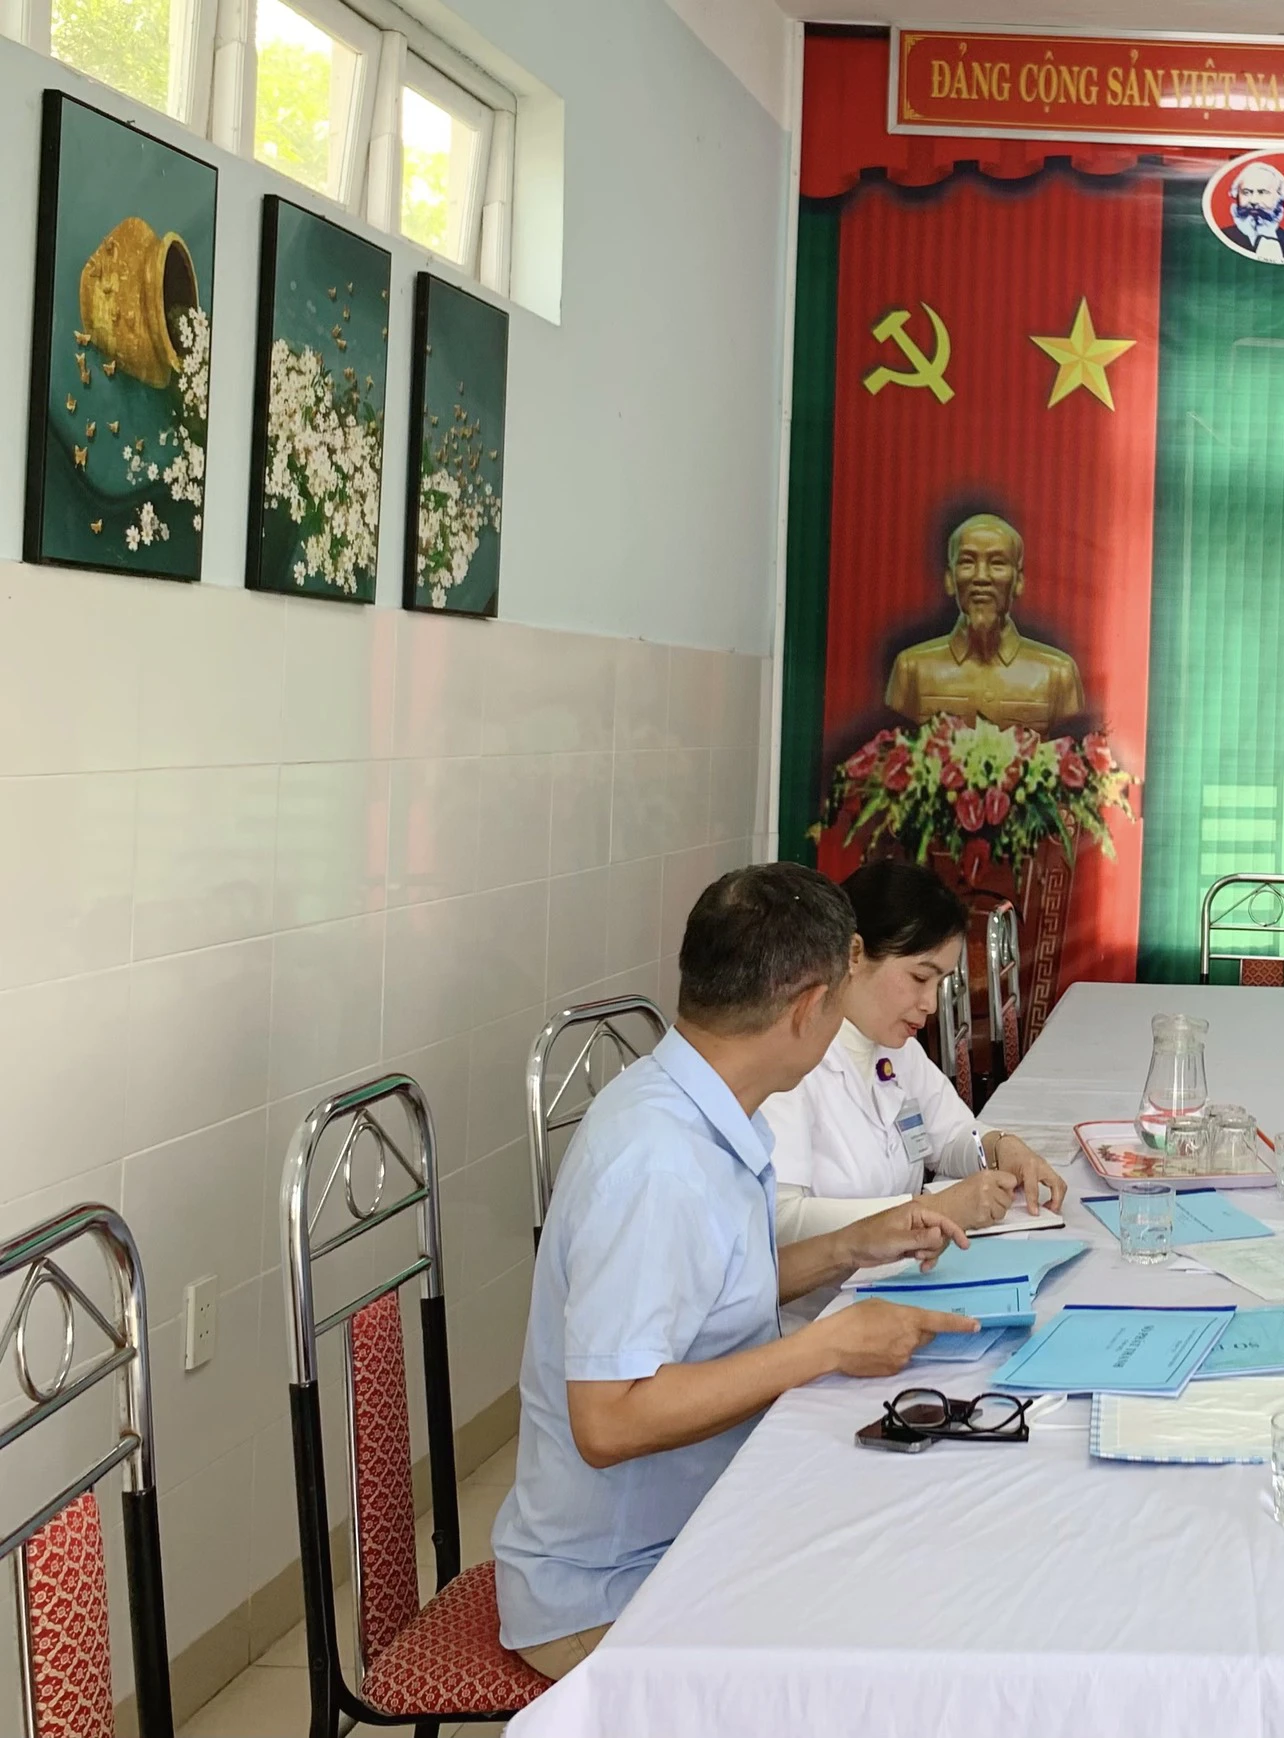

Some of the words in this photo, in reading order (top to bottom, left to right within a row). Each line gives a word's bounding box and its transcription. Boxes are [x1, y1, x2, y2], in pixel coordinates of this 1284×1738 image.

[931, 42, 1010, 102] ĐẢNG
[1019, 50, 1098, 113] CỘNG
[1106, 49, 1164, 107] SẢN
[1171, 58, 1236, 120] VIỆT
